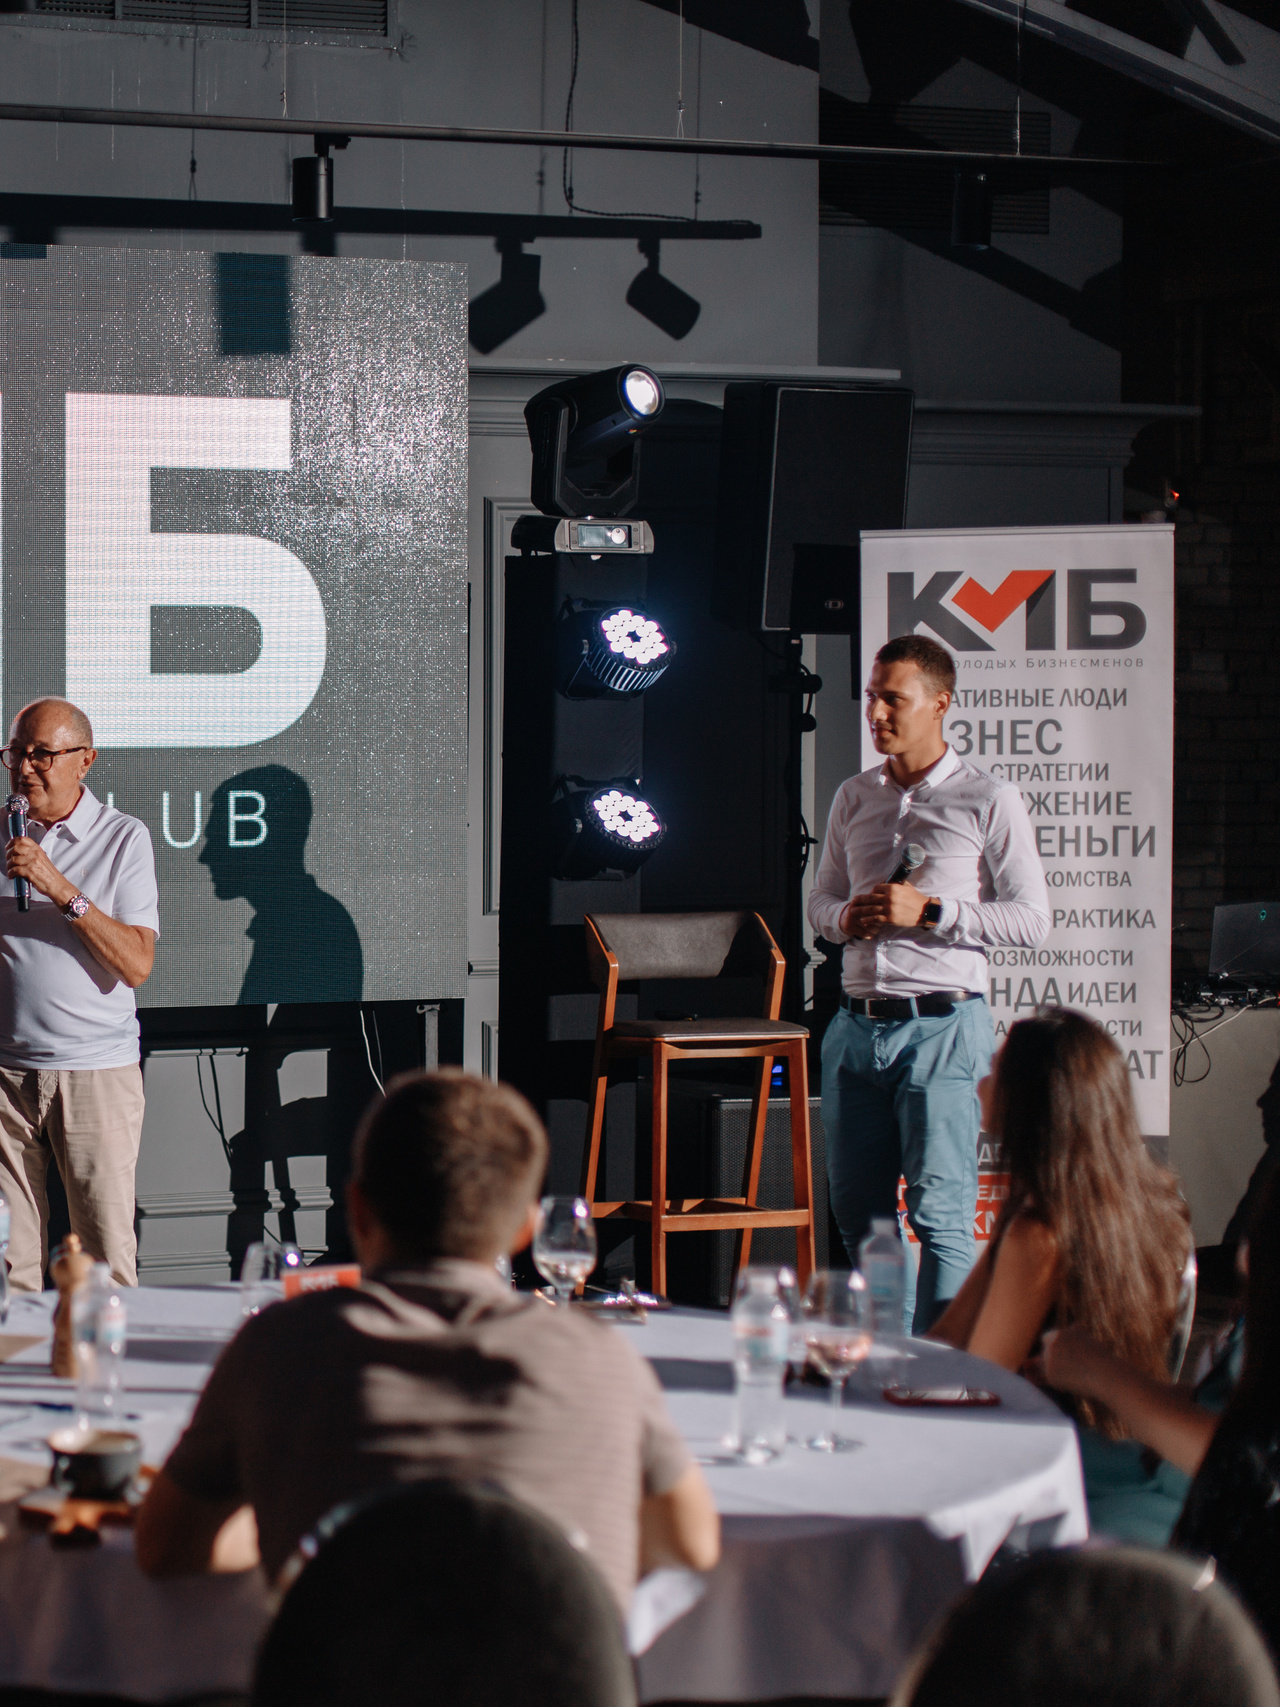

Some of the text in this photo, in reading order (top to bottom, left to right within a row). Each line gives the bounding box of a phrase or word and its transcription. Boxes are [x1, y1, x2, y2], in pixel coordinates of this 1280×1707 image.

[953, 659, 1017, 670] ОЛОДЫХ
[950, 687, 1128, 710] АТИВНЫЕ ЛЮДИ
[948, 718, 1063, 756] ЗНЕС
[990, 763, 1110, 782] СТРАТЕГИИ
[1021, 791, 1133, 816] ЖЕНИЕ
[1035, 825, 1156, 858] ЕНЬГИ
[1044, 870, 1133, 888] КОМСТВА
[1052, 908, 1157, 929] РАКТИКА
[1068, 982, 1137, 1007] ИДЕИ
